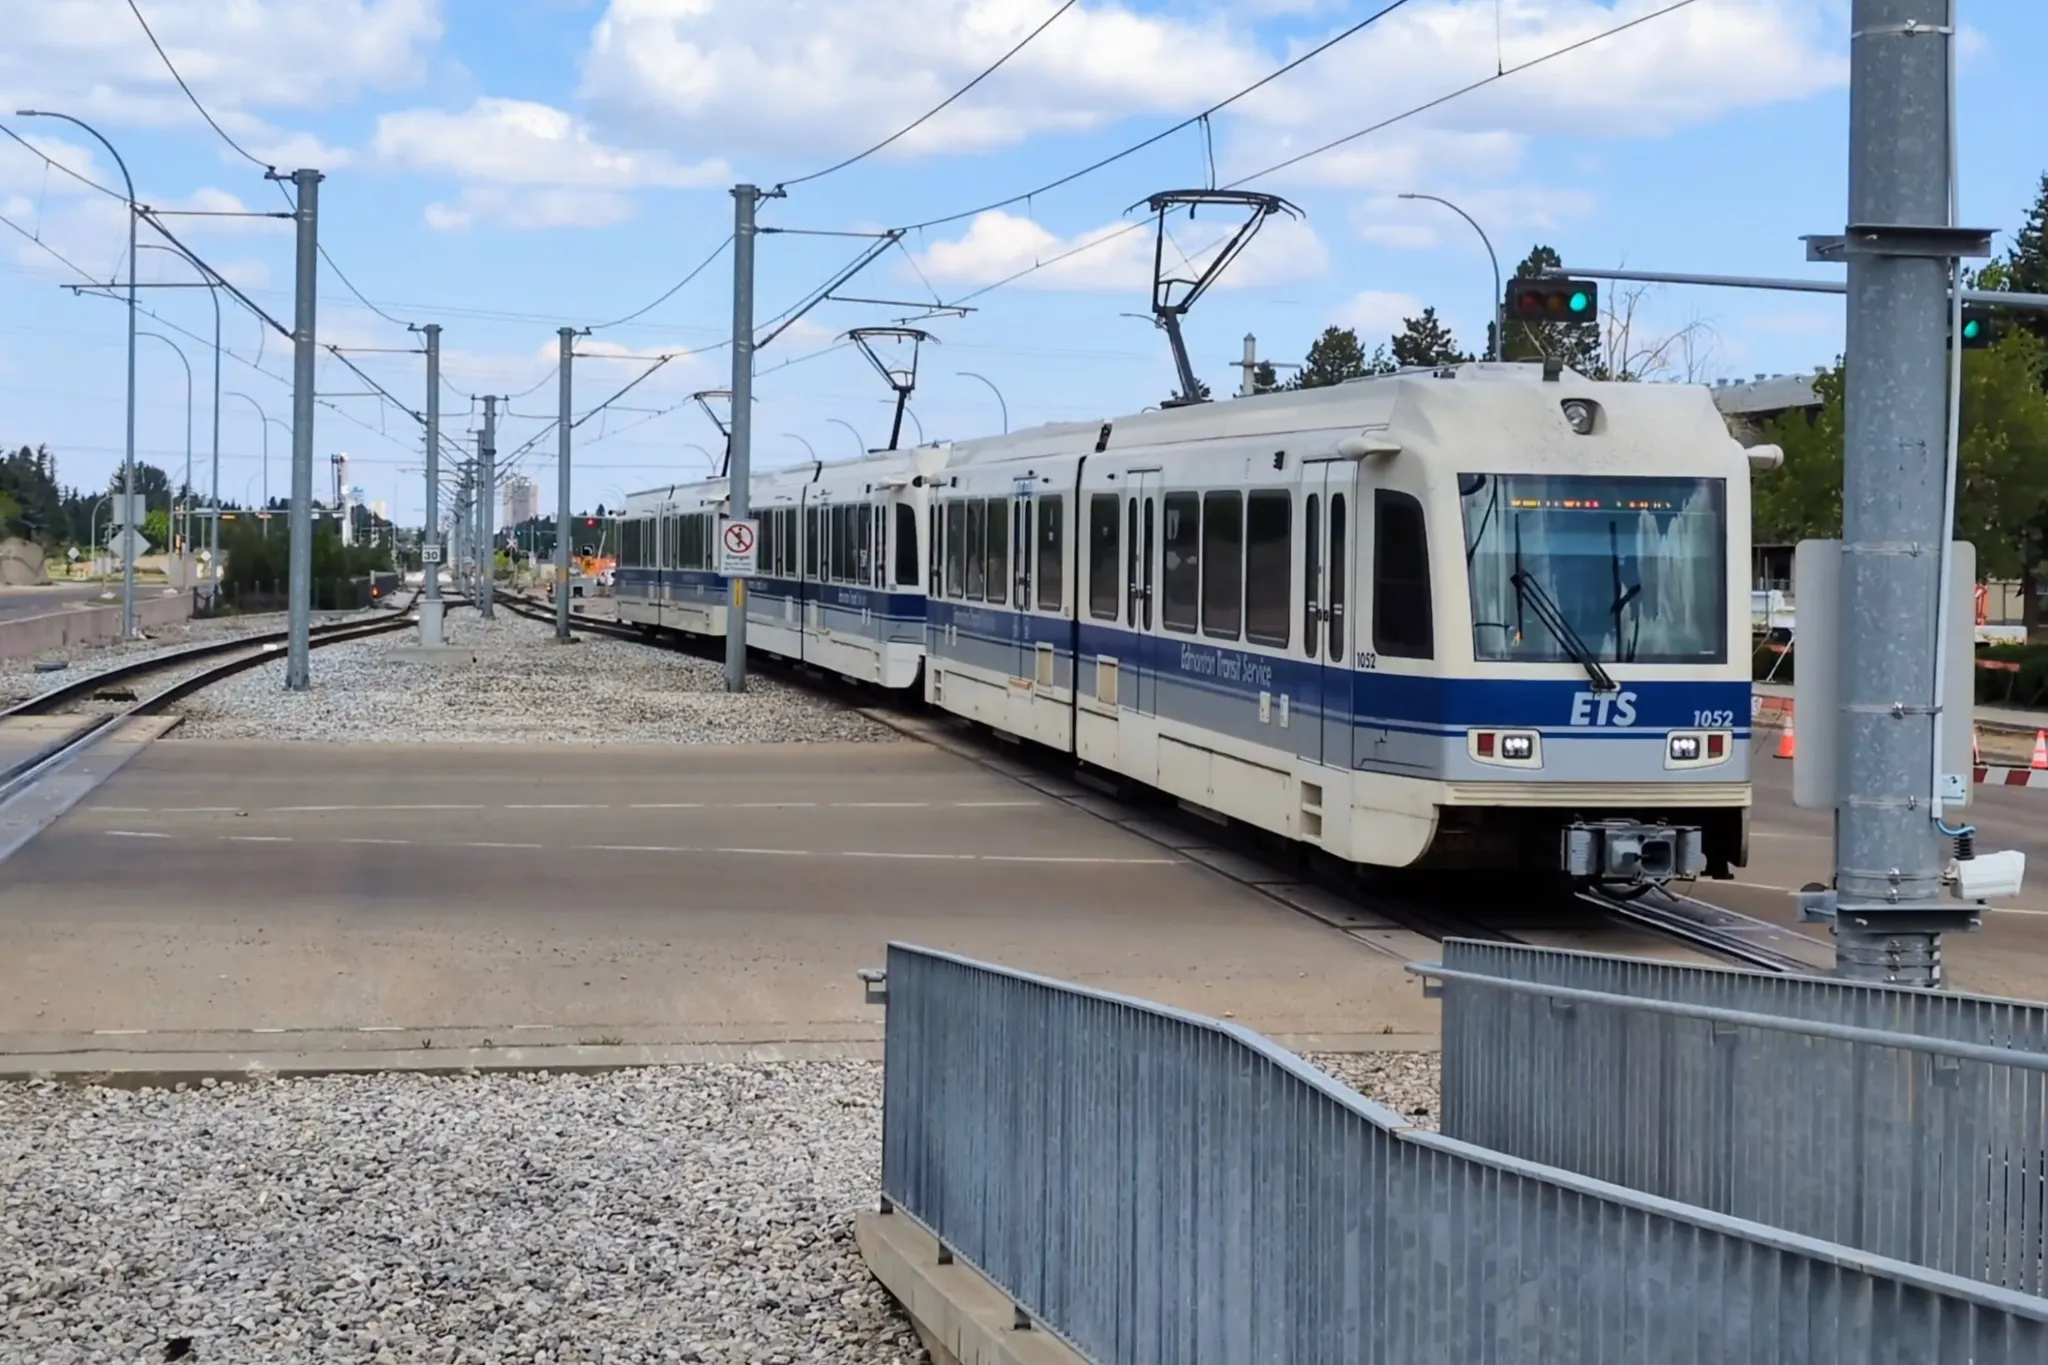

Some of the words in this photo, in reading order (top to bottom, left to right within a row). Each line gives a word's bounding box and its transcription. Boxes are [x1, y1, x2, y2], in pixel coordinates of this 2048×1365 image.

[423, 551, 438, 560] 30
[1180, 643, 1216, 675] Edmonton
[1216, 649, 1241, 680] Transit
[1242, 653, 1272, 687] Service
[1357, 651, 1376, 669] 1052
[1570, 691, 1638, 727] ETS
[1693, 710, 1734, 727] 1052
